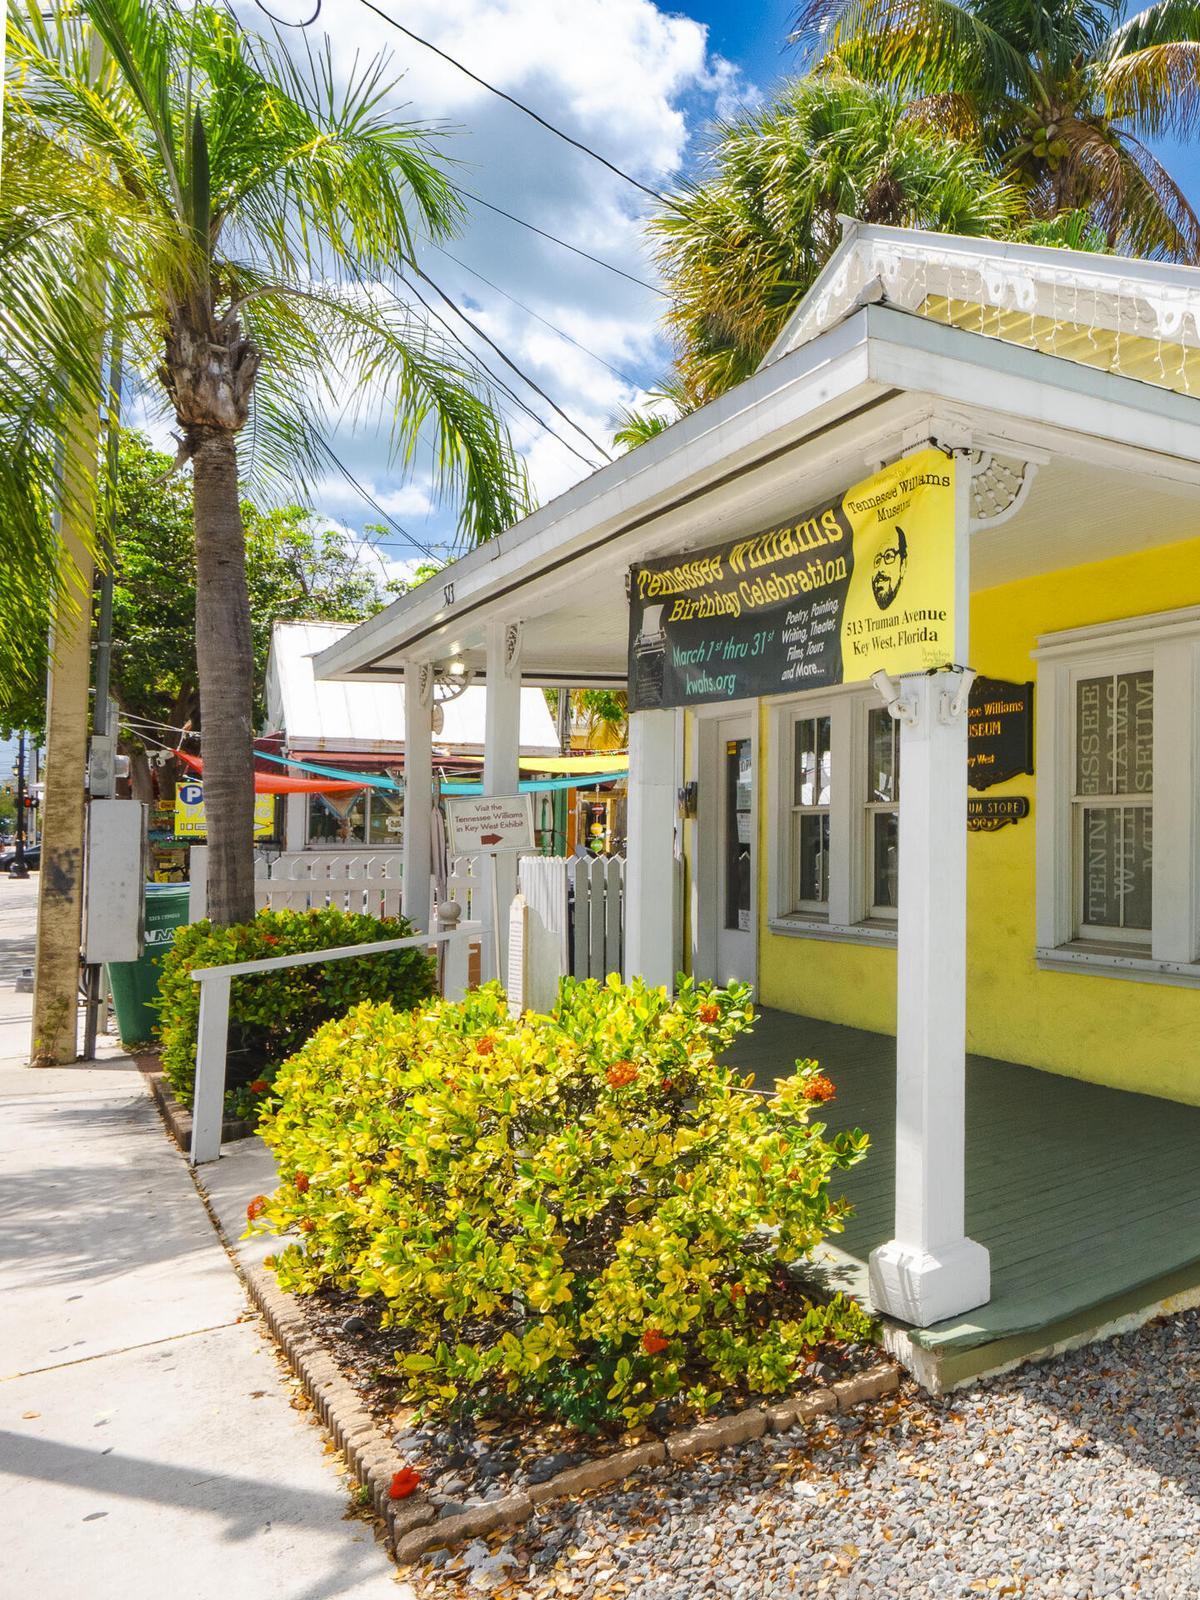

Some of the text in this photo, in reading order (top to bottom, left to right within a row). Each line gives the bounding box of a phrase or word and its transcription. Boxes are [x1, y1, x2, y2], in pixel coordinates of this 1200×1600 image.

[637, 509, 844, 600] Tennessee Williams
[668, 556, 848, 622] Birthday Celebration
[846, 610, 947, 636] 513 Truman Avenue
[672, 641, 705, 667] March
[722, 636, 748, 660] thru
[751, 629, 775, 656] 31st
[806, 641, 824, 655] Tours
[852, 627, 938, 656] Key West, Florida
[781, 662, 796, 680] and
[686, 669, 737, 695] kwahs.org
[984, 700, 1024, 716] Williams
[967, 721, 1001, 738] SEUM
[967, 754, 995, 768] ey West
[474, 803, 503, 812] Visit the
[988, 801, 1019, 813] STORE
[455, 811, 523, 823] Tennessee Williams
[465, 824, 479, 832] Key
[500, 820, 524, 829] Exhibit
